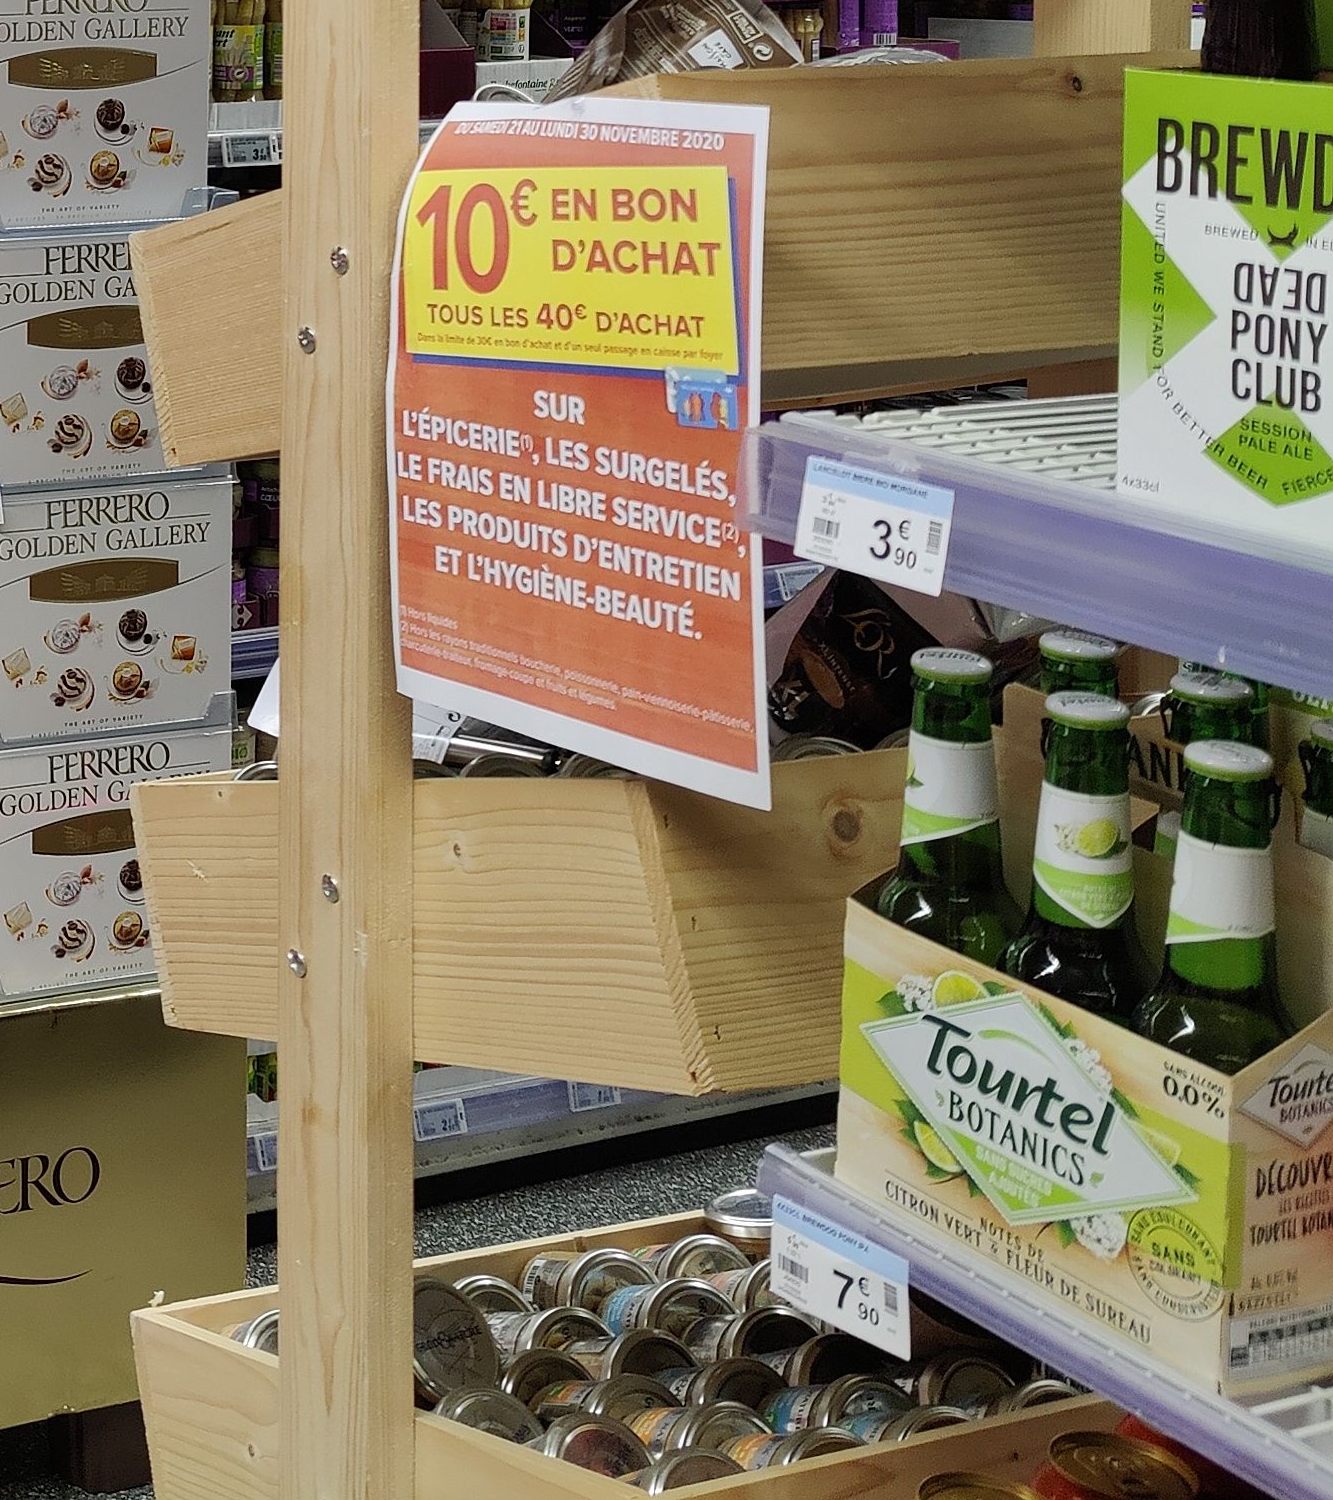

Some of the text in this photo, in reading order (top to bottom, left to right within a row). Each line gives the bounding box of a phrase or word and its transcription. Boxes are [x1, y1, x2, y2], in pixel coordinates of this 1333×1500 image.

[84, 16, 190, 41] GALLERY
[454, 121, 725, 151] DU SAMEDI 21 AU LUNDI 30 NOVEMBRE 2020
[552, 189, 601, 221] EN
[612, 189, 698, 222] BON
[1153, 201, 1167, 264] UNITED
[1204, 223, 1259, 242] BREWED
[552, 240, 721, 276] D'ACHAT
[1153, 269, 1166, 296] WE
[1234, 262, 1327, 315] DEAD
[427, 303, 705, 338] TOUS LES 40€ D'ACHAT
[1152, 301, 1165, 360] STAND
[1231, 309, 1329, 365] PONY
[1231, 358, 1322, 413] CLUB
[533, 389, 586, 426] SUR
[1238, 434, 1314, 462] PALE ALE
[1239, 417, 1313, 444] SESSION
[397, 450, 423, 482] LE
[428, 457, 494, 497] FRAIS
[499, 471, 532, 506] EN
[537, 478, 607, 523] LIBRE
[545, 436, 591, 472] LES
[595, 448, 738, 508] SURGELÉS,
[1227, 454, 1269, 490] BEER
[44, 490, 171, 530] FERRERO
[105, 521, 211, 551] GALLERY
[402, 494, 742, 602] LES PRODUITS D'ENTRETIEN
[435, 544, 462, 574] ET
[921, 1014, 1114, 1155] Tourtel
[946, 1090, 1086, 1188] BOTANICS
[979, 1215, 1046, 1265] NOTES DE
[1151, 1241, 1196, 1268] SANS
[885, 1178, 1152, 1345] CITRON VERT FLEUR DE SUREAU
